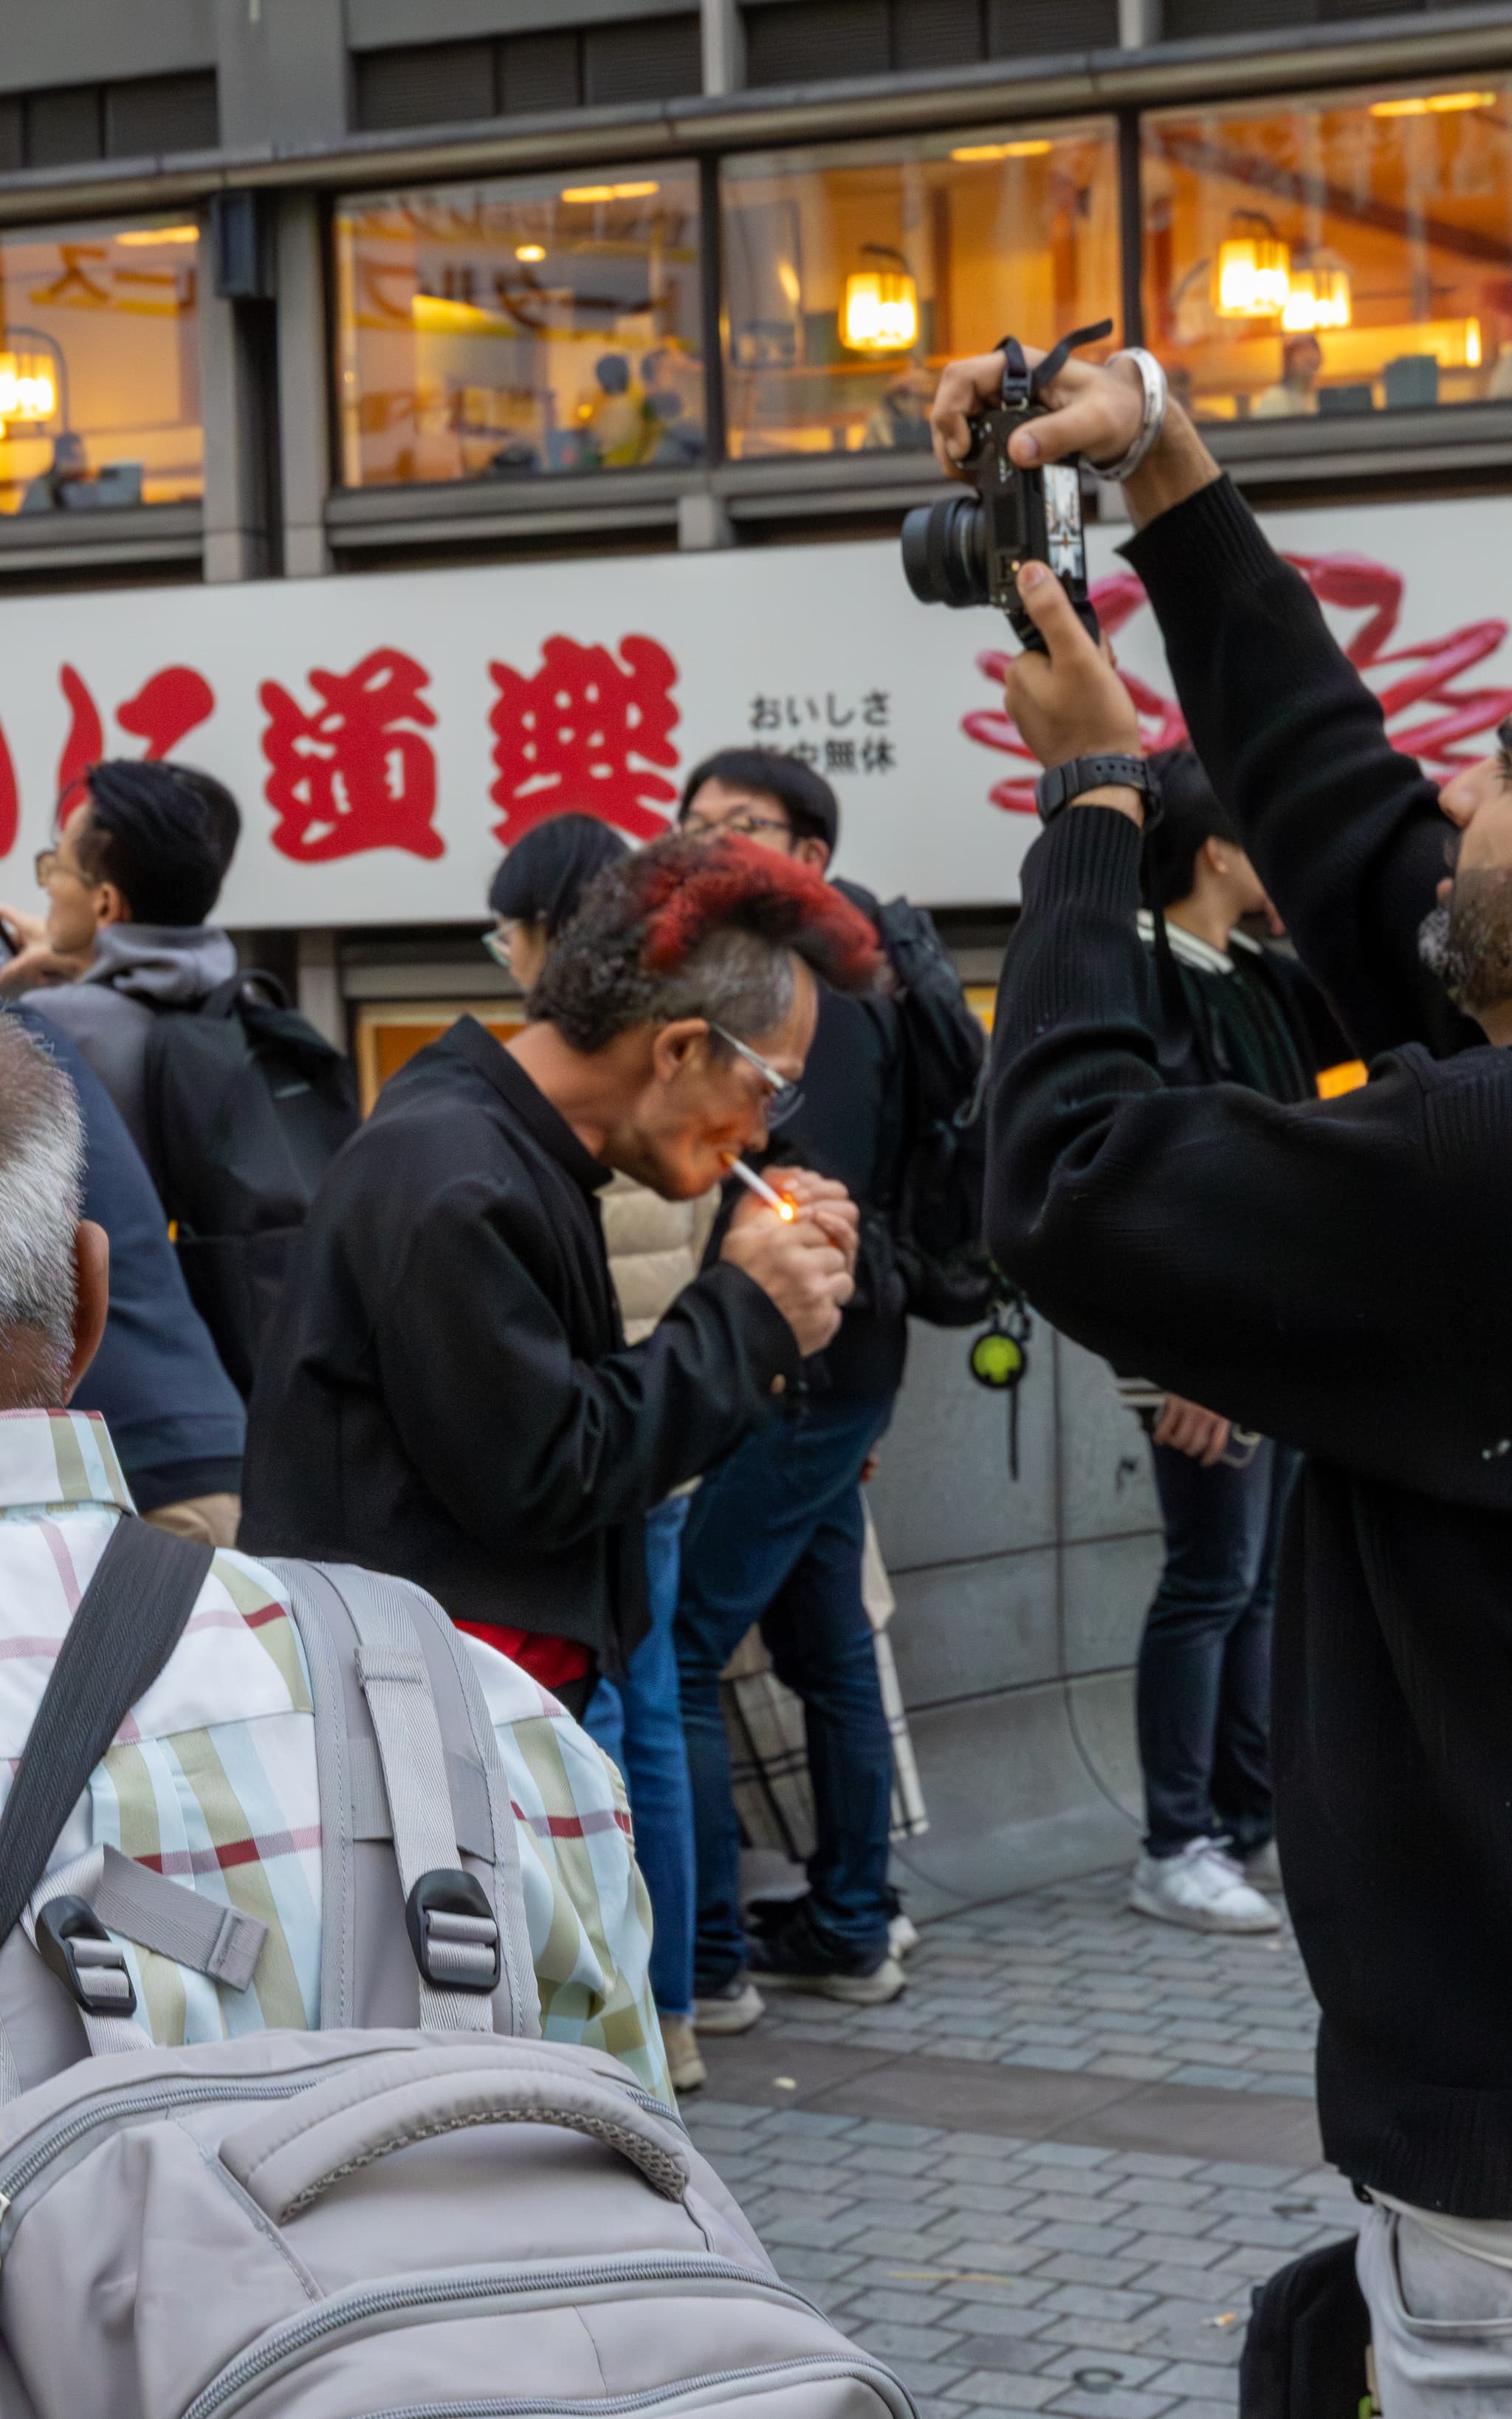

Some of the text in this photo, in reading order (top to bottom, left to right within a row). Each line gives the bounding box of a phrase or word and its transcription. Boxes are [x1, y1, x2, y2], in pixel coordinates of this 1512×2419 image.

[749, 691, 890, 730] おいしさ
[0, 633, 681, 863] に道樂
[752, 735, 896, 775] 中無休
